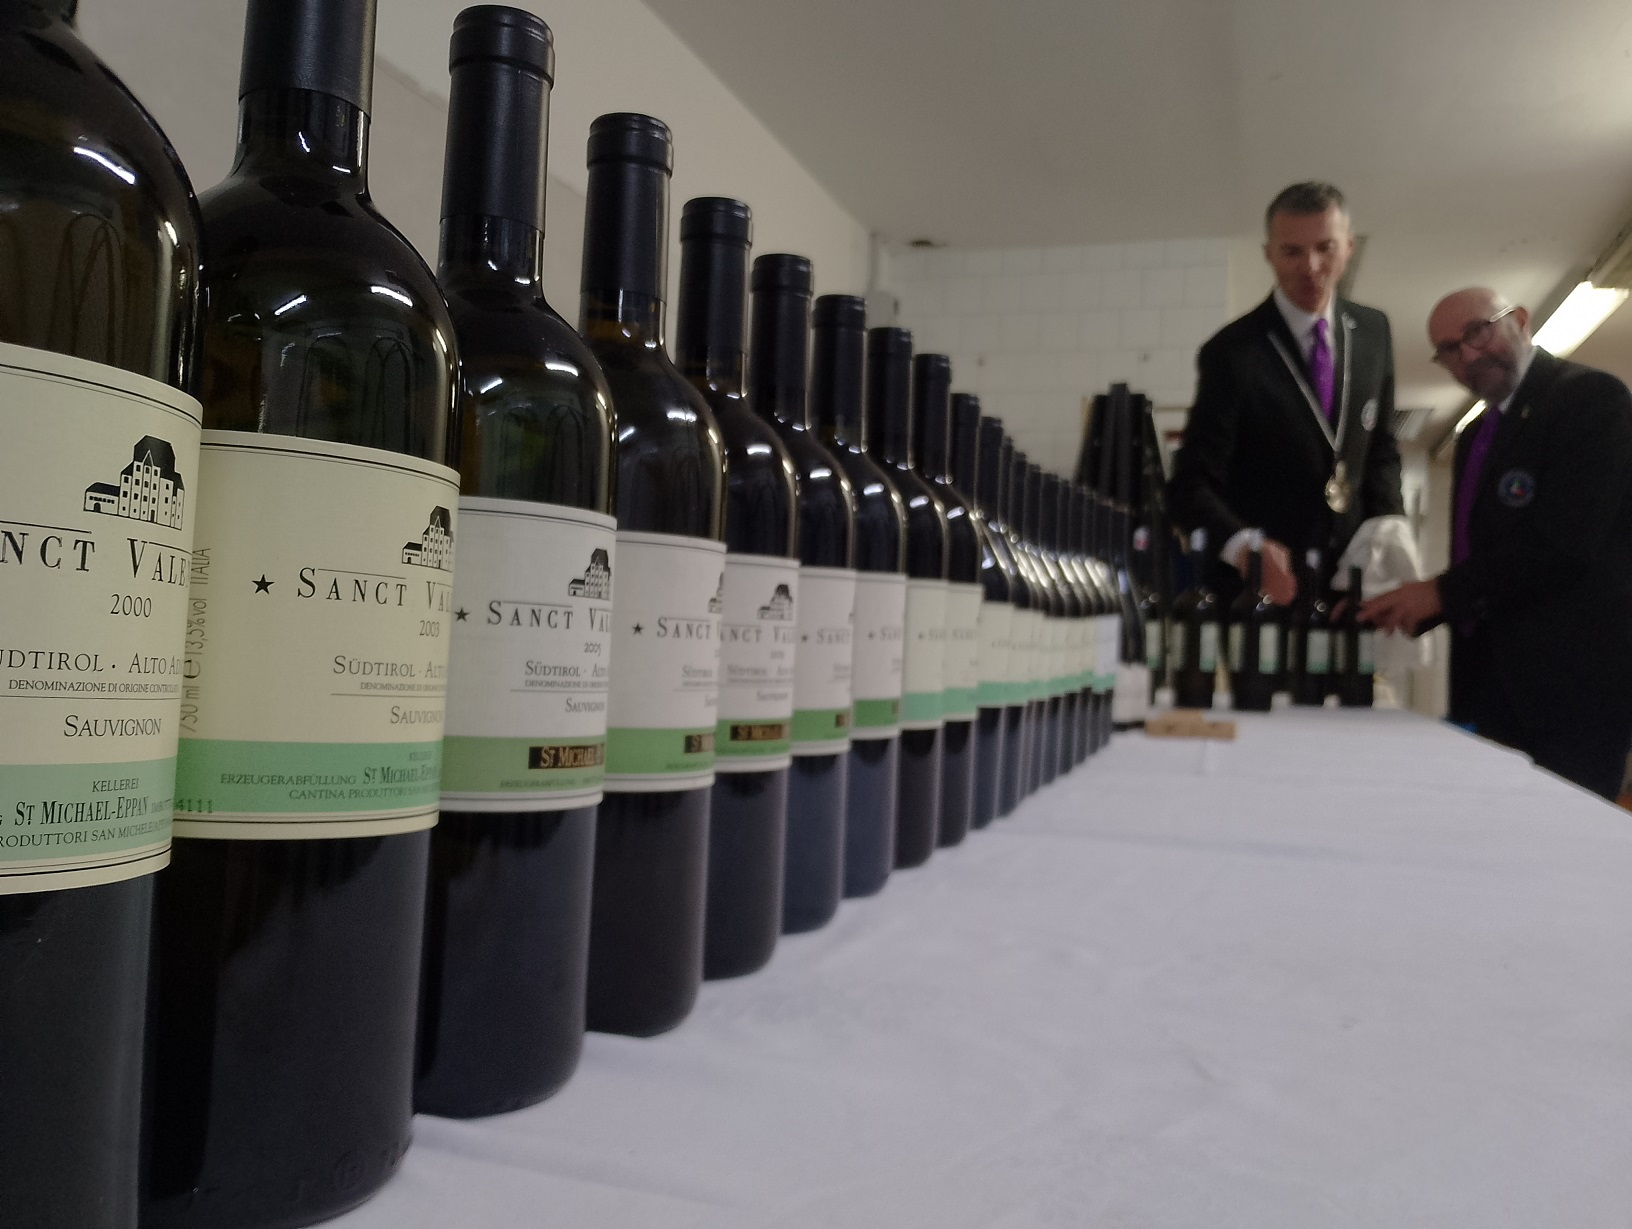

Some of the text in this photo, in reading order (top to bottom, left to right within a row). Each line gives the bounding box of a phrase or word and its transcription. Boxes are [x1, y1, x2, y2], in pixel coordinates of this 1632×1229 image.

[297, 567, 407, 606] SANCT
[110, 594, 152, 617] 2000
[487, 600, 574, 630] SANCT
[419, 620, 440, 638] 2003
[656, 616, 711, 640] SANCT
[128, 652, 167, 675] ALTO
[333, 655, 416, 677] SÜDTIROL
[525, 660, 581, 677] SÜDTIROL
[8, 679, 106, 693] DENOMINAZIONE
[108, 682, 117, 693] DI
[119, 683, 149, 694] ORIGINE
[63, 715, 162, 737] SAUVIGNON
[92, 778, 139, 792] KELLEREI
[289, 788, 345, 800] CANTINA
[91, 828, 116, 842] SAN
